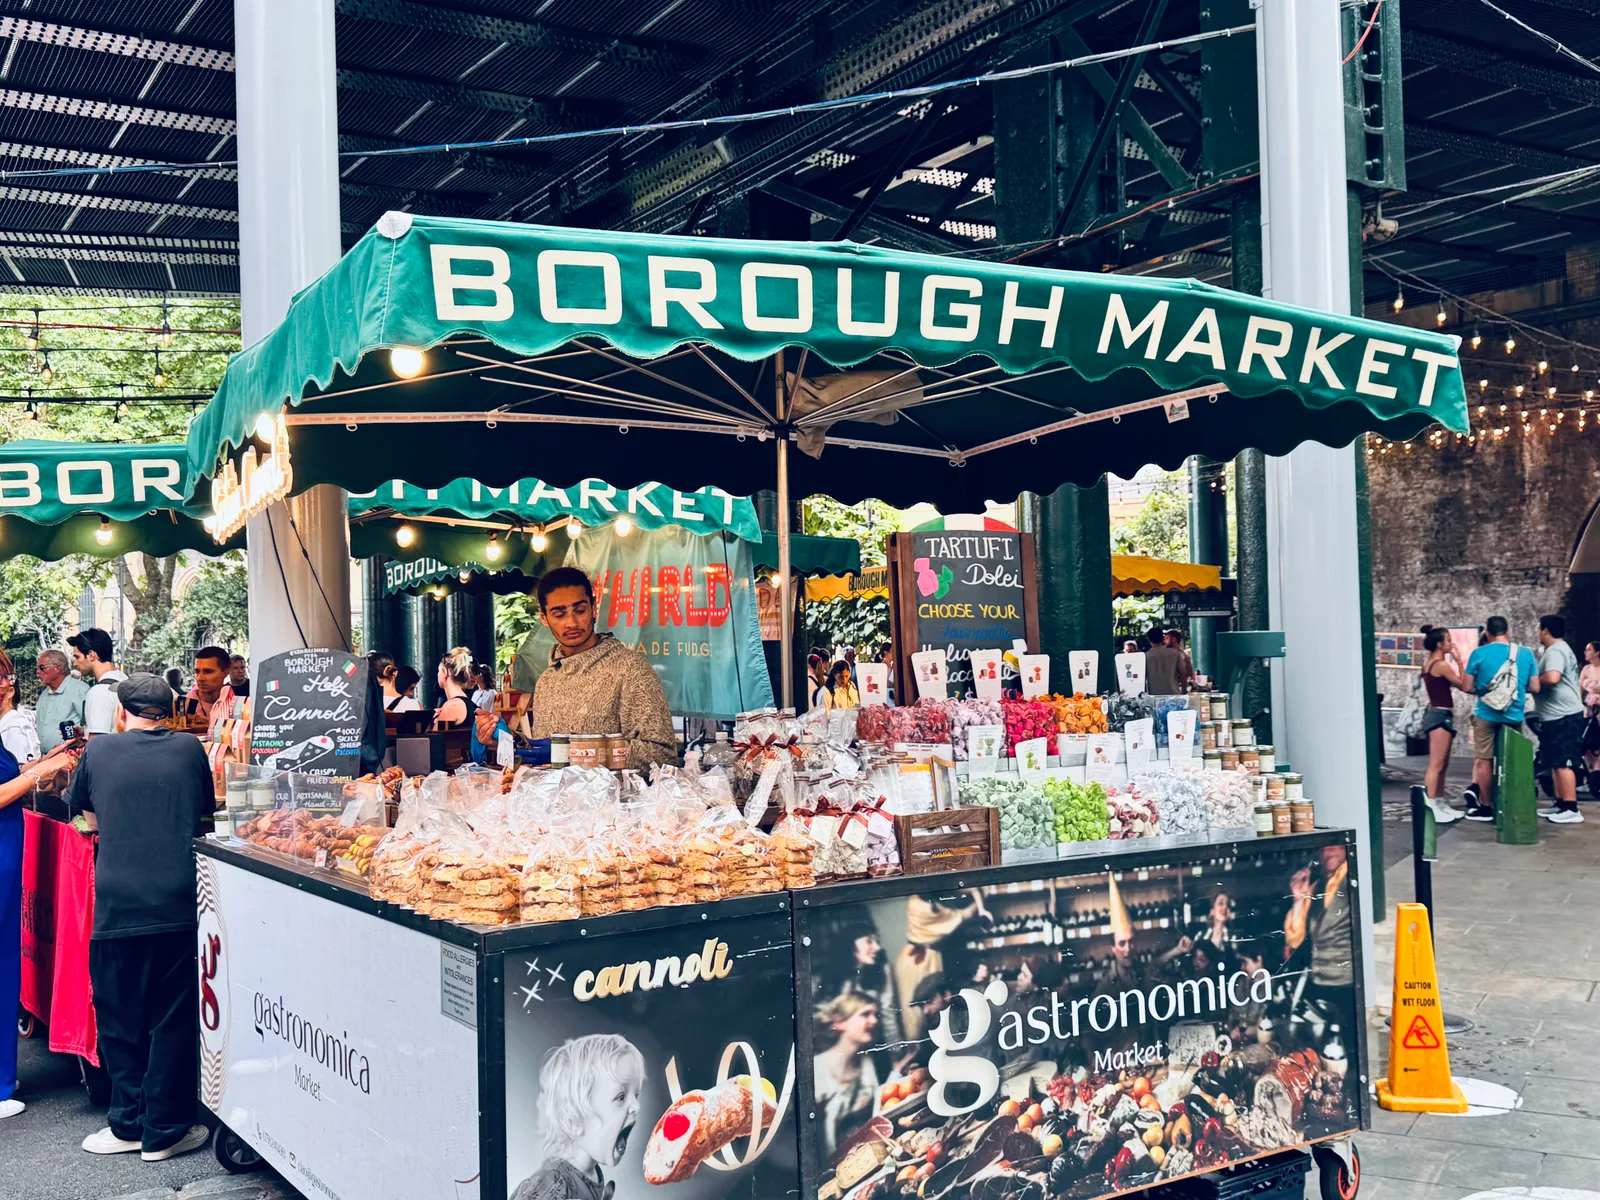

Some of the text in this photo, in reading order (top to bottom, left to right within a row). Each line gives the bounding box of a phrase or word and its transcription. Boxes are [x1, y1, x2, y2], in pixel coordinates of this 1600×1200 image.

[430, 243, 1458, 406] BOROUGH MARKET
[0, 459, 185, 507] BOR
[924, 537, 1014, 560] TARTUFI
[386, 557, 448, 589] BOROU
[918, 603, 1020, 619] CHOOSE YOUR
[678, 642, 712, 657] FUDG
[285, 656, 334, 667] BOROUGH
[288, 664, 329, 674] MARKET
[303, 675, 352, 697] Holy
[263, 695, 357, 721] Cannoli
[279, 724, 294, 734] your
[309, 768, 337, 776] CRISPY
[275, 792, 289, 801] OUR
[573, 937, 733, 1002] cannoli
[1404, 982, 1432, 990] CAUTION
[1402, 998, 1436, 1006] WET FLOOR
[254, 992, 370, 1095] gastronomica
[927, 961, 1273, 1118] gastronomica
[1093, 1040, 1163, 1074] Market
[295, 1064, 322, 1102] Market
